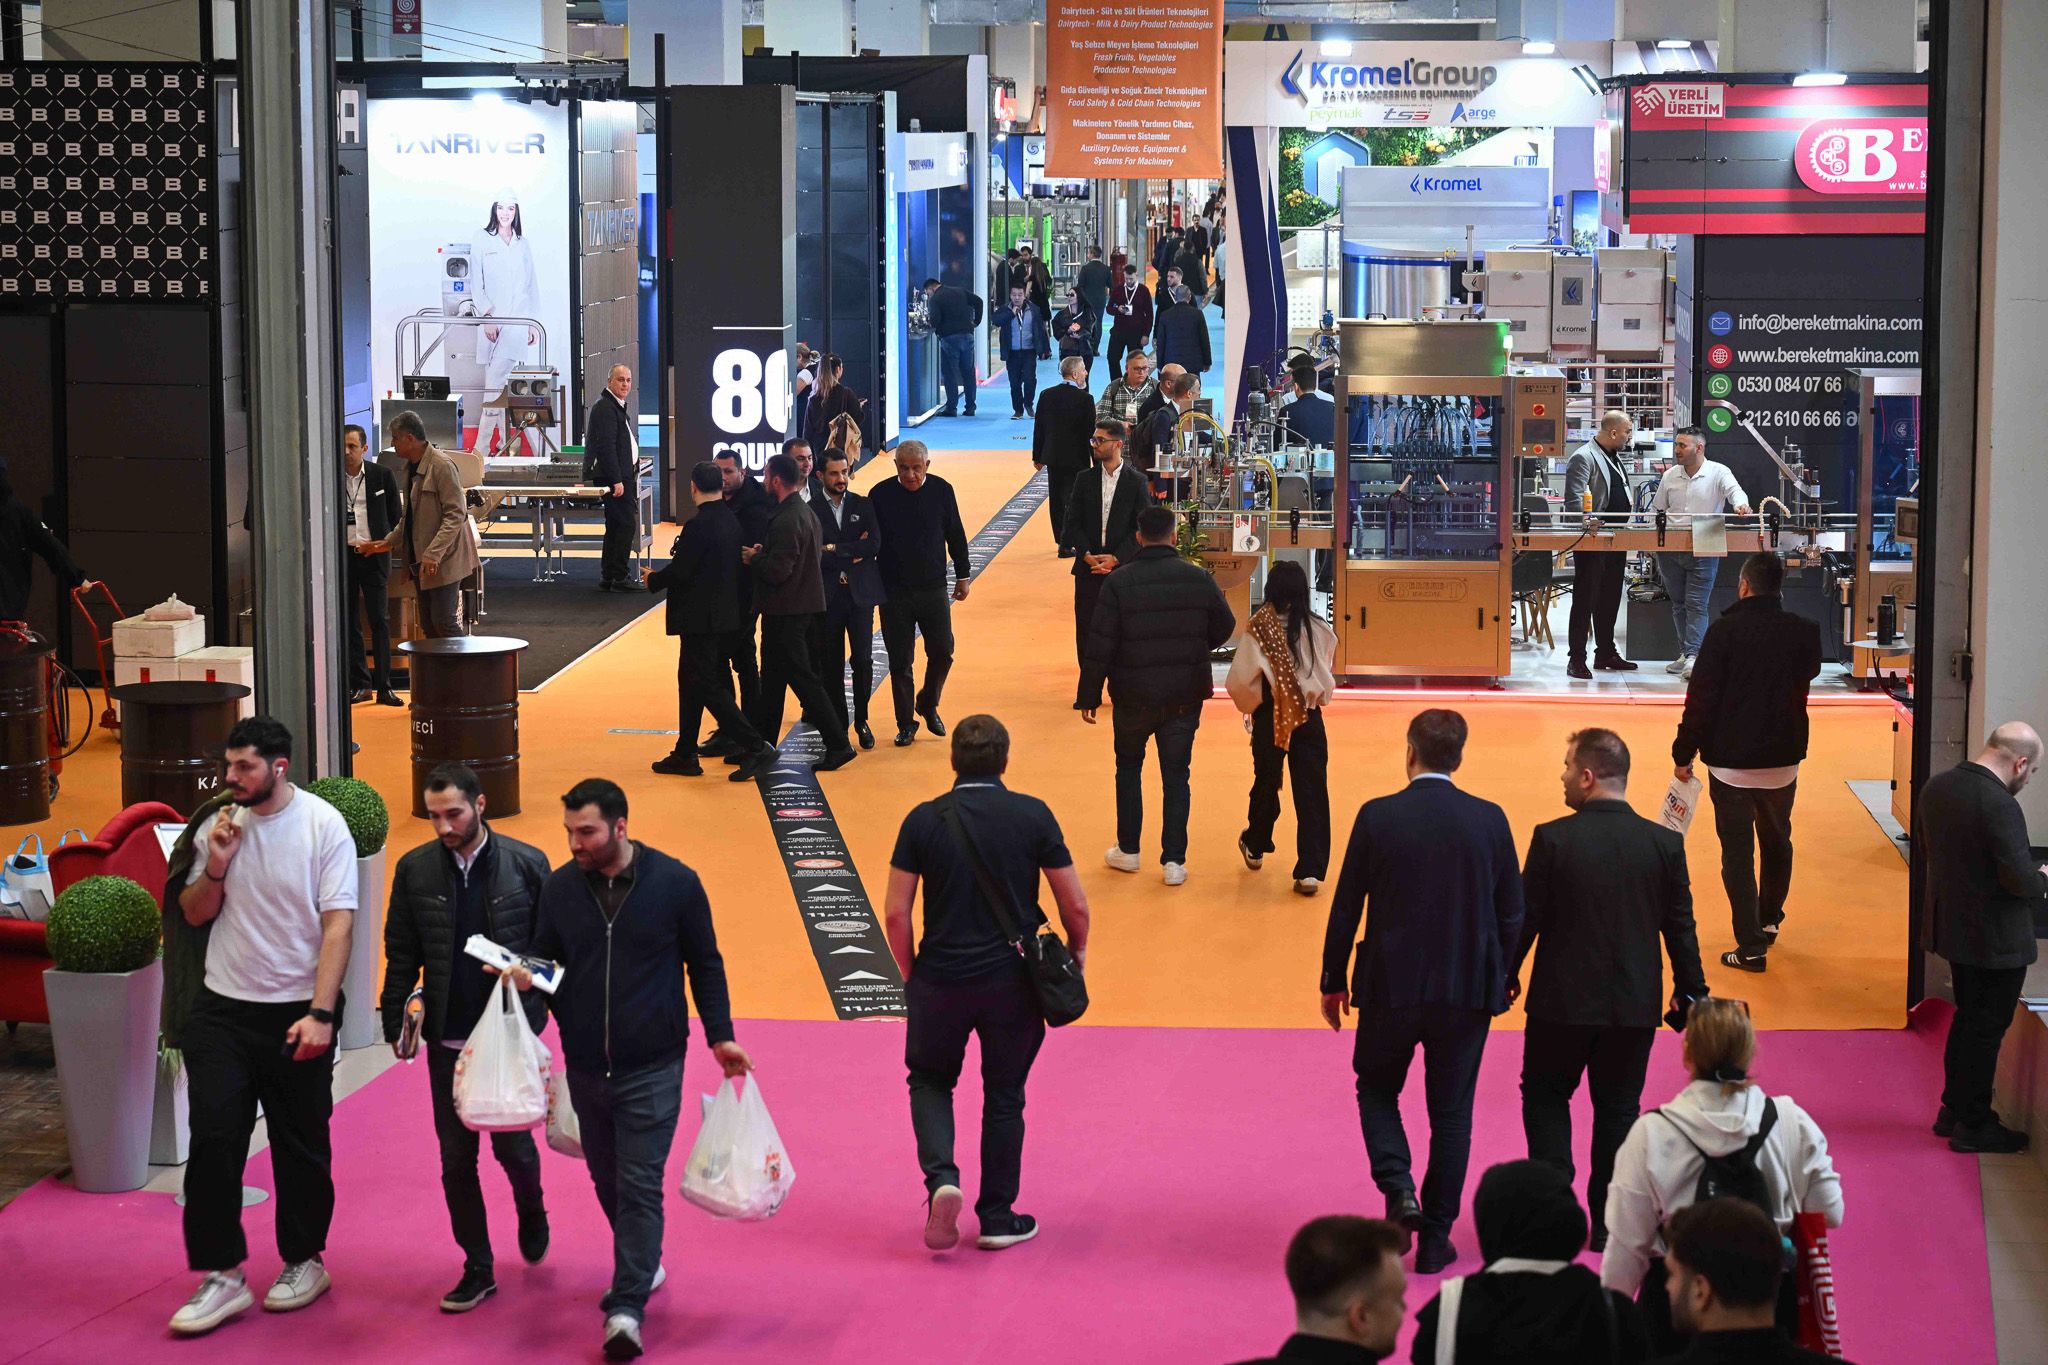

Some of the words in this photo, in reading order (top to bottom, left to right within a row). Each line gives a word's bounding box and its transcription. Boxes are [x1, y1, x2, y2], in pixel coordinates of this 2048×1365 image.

[1062, 7, 1095, 16] Dairytech
[1101, 7, 1112, 15] Süt
[1124, 7, 1136, 15] Süt
[1138, 6, 1164, 15] Ürünleri
[1167, 7, 1208, 16] Teknolojileri
[1058, 20, 1089, 28] Dairytech
[1097, 20, 1110, 28] Milk
[1121, 20, 1140, 29] Dairy
[1168, 21, 1213, 30] Technologies
[1071, 40, 1083, 50] Yaş
[1107, 41, 1130, 50] Meyve
[1132, 40, 1154, 50] İşleme
[1157, 41, 1198, 50] Teknolojileri
[1115, 54, 1136, 62] Fruits,
[1139, 55, 1176, 63] Vegetables
[1093, 66, 1129, 74] Production
[1132, 66, 1176, 75] Technologies
[1061, 86, 1076, 94] Gıda
[1078, 86, 1109, 95] Güvenliği
[1121, 87, 1142, 95] Soğuk
[1165, 87, 1207, 96] Teknolojileri
[1357, 90, 1417, 101] PROCESSING
[1419, 90, 1478, 101] EQUIPMENT
[1669, 86, 1709, 100] YERLİ
[1087, 99, 1107, 108] Safety
[1110, 99, 1115, 107] &
[1118, 99, 1132, 107] Cold
[1135, 99, 1153, 107] Chain
[1156, 100, 1200, 109] Technologies
[1667, 101, 1720, 115] ÜRETİM
[1114, 119, 1139, 127] Yönelik
[1141, 120, 1171, 128] Yardımcı
[1173, 120, 1194, 129] Cihaz,
[1097, 132, 1126, 140] Donanım
[1138, 132, 1170, 140] Sistemler
[1081, 144, 1110, 153] Auxiliary
[1112, 145, 1141, 153] Devices,
[1143, 145, 1179, 154] Equipment
[1094, 157, 1122, 166] Systems
[1137, 158, 1173, 166] Machinery
[1423, 177, 1482, 191] Kromel
[1739, 314, 1922, 334] info@bereketmakina.com
[1738, 348, 1918, 364] www.bereketmakina.com
[1738, 376, 1771, 392] 0530
[1775, 376, 1800, 392] 084
[1803, 376, 1821, 392] 07
[1824, 376, 1842, 392] 66
[1774, 411, 1800, 427] 610
[1803, 411, 1821, 427] 66
[1823, 411, 1841, 427] 66
